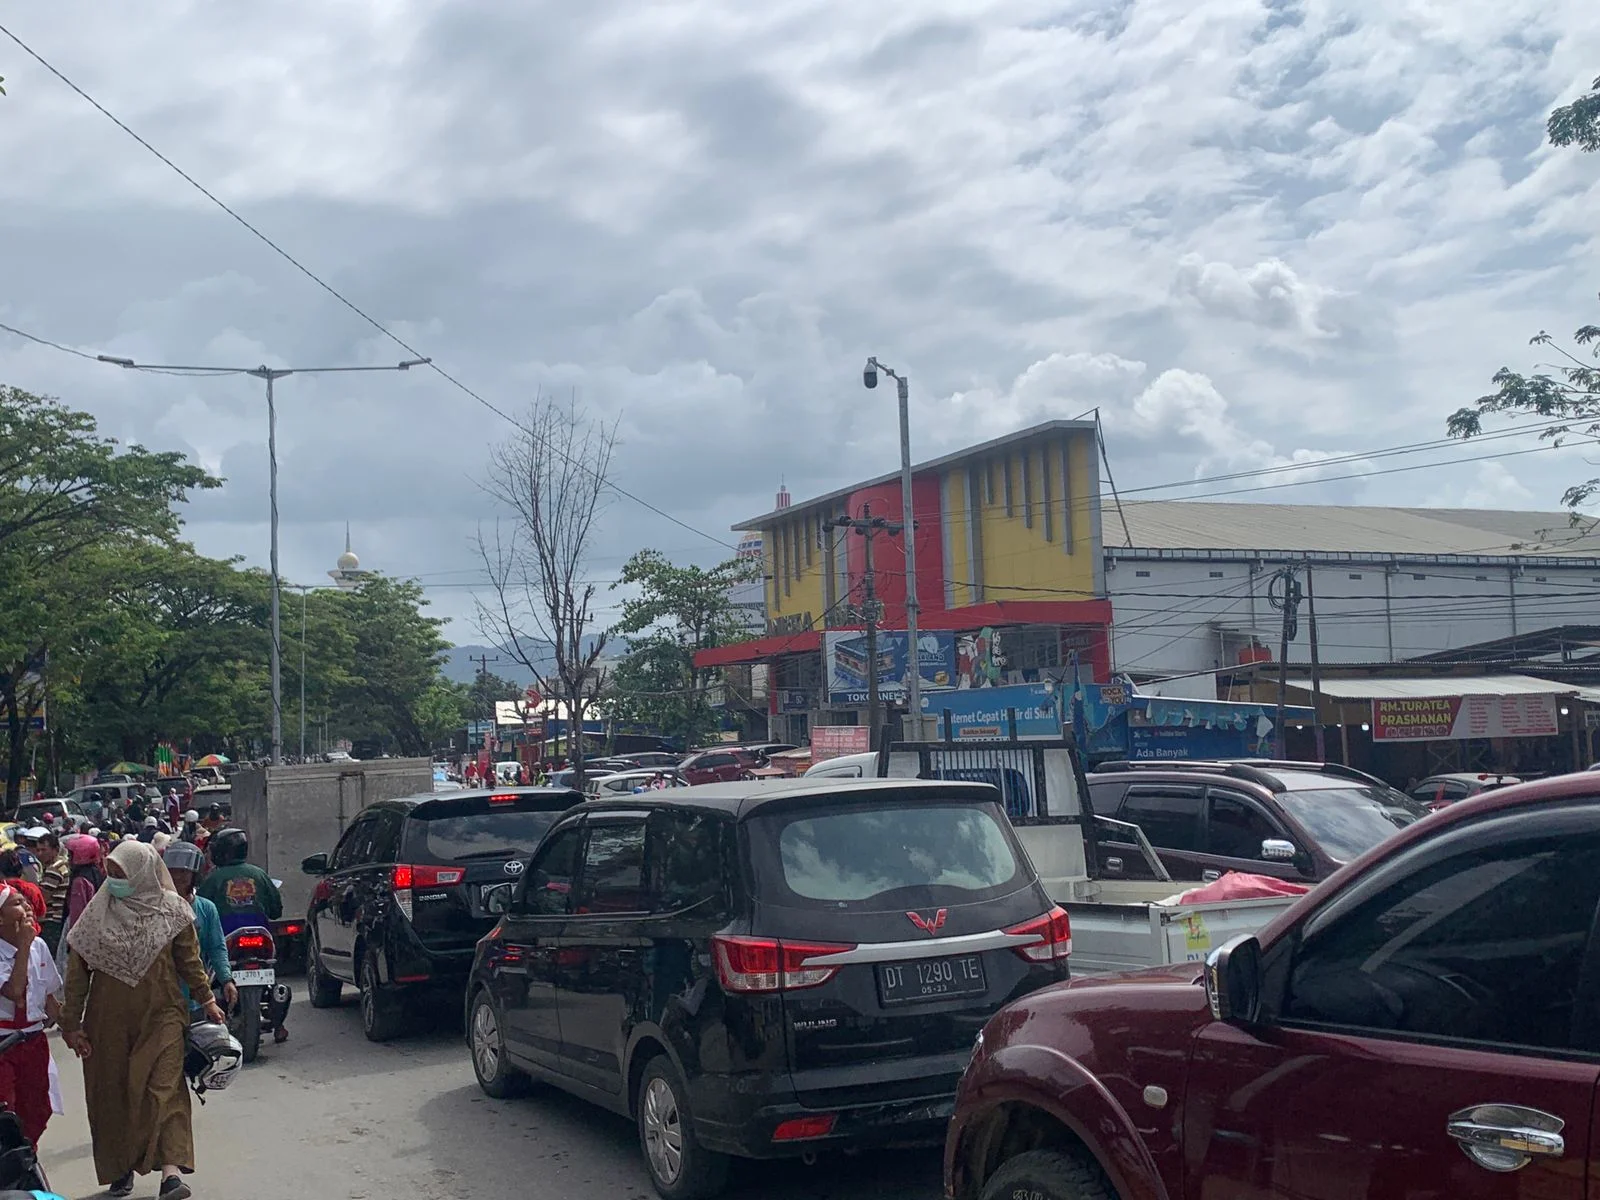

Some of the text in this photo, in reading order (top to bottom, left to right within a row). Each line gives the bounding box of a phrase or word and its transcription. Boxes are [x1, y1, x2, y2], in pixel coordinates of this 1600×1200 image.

[1380, 700, 1450, 711] RM.TURATEA
[977, 710, 999, 725] Cepat
[1000, 707, 1023, 721] Hir
[1024, 706, 1033, 720] di
[1380, 713, 1452, 725] PRASMANAN
[1136, 748, 1154, 758] Ada
[1156, 747, 1189, 759] Banyak
[885, 958, 980, 989] DT 1290 TE
[793, 1018, 838, 1030] WULING
